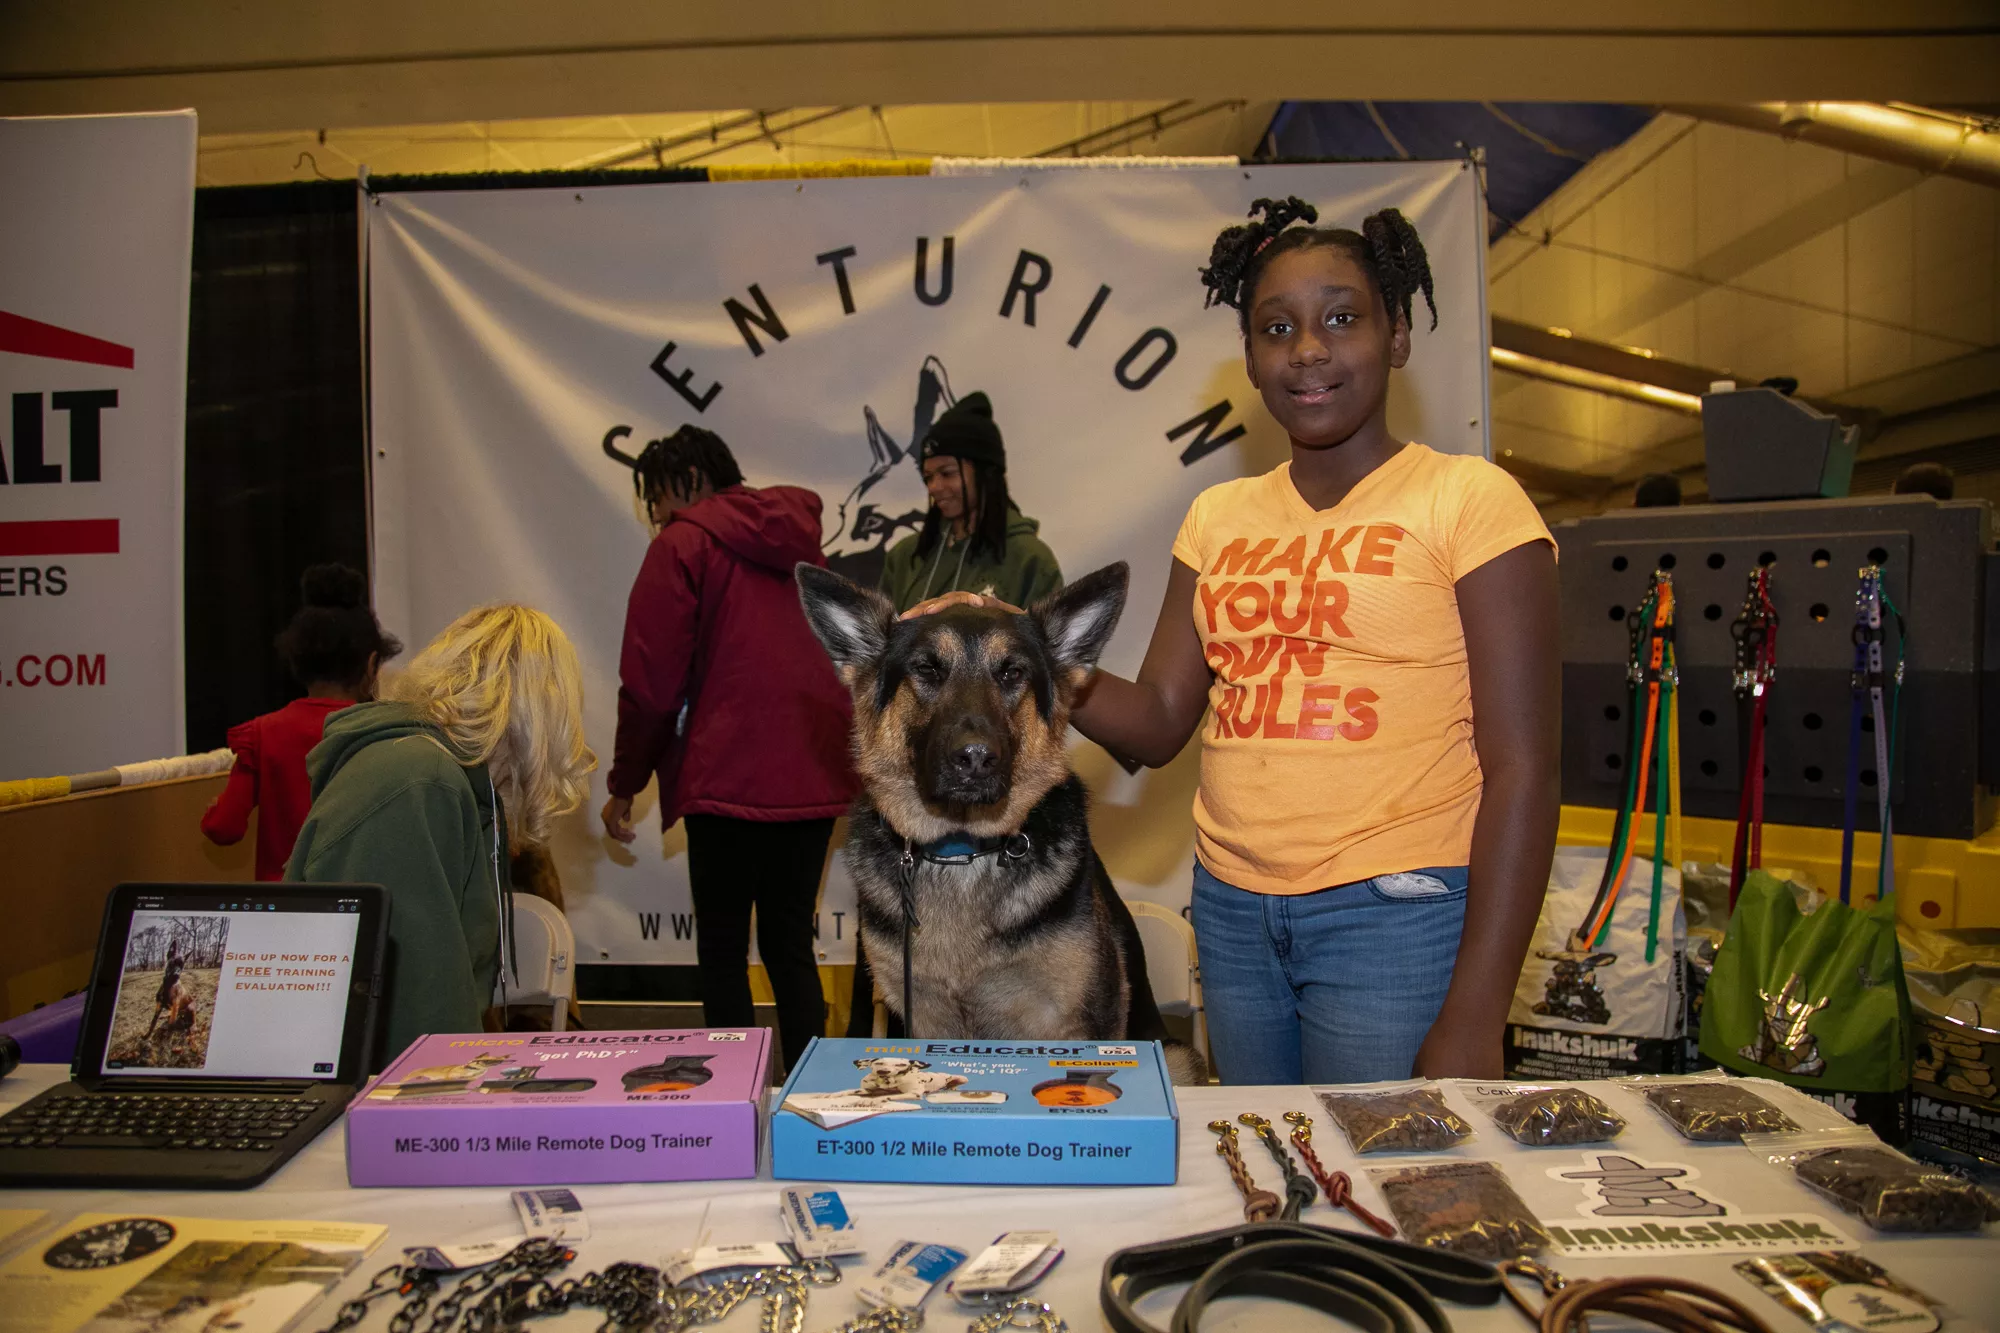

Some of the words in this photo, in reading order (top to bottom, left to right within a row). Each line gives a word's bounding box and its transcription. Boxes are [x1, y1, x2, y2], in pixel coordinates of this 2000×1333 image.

[602, 236, 1247, 469] CENTURION
[0, 389, 118, 485] LT
[1209, 525, 1405, 577] MAKE
[1200, 580, 1355, 638] YOUR
[0, 653, 106, 687] .COM
[1205, 635, 1332, 682] OWN
[1216, 684, 1380, 741] RULES
[235, 967, 272, 977] FREE
[341, 955, 350, 963] A
[449, 1038, 524, 1048] micro
[865, 1046, 921, 1054] mini
[1513, 1027, 1637, 1061] Inukshuk
[991, 1061, 1017, 1070] your
[395, 1136, 460, 1153] ME-300
[466, 1136, 491, 1152] 1/3
[496, 1135, 531, 1151] Mile
[536, 1135, 605, 1151] Remote
[610, 1134, 645, 1153] Dog
[651, 1132, 713, 1149] Trainer
[817, 1140, 875, 1156] ET-300
[880, 1140, 905, 1156] 1/2
[912, 1141, 947, 1157] Mile
[954, 1142, 1021, 1158] Remote
[1027, 1143, 1063, 1161] Dog
[1068, 1143, 1132, 1158] Trainer
[1546, 1219, 1839, 1245] Inukshuk
[1738, 1240, 1778, 1248] DOG
[1793, 1239, 1845, 1248] FOOD
